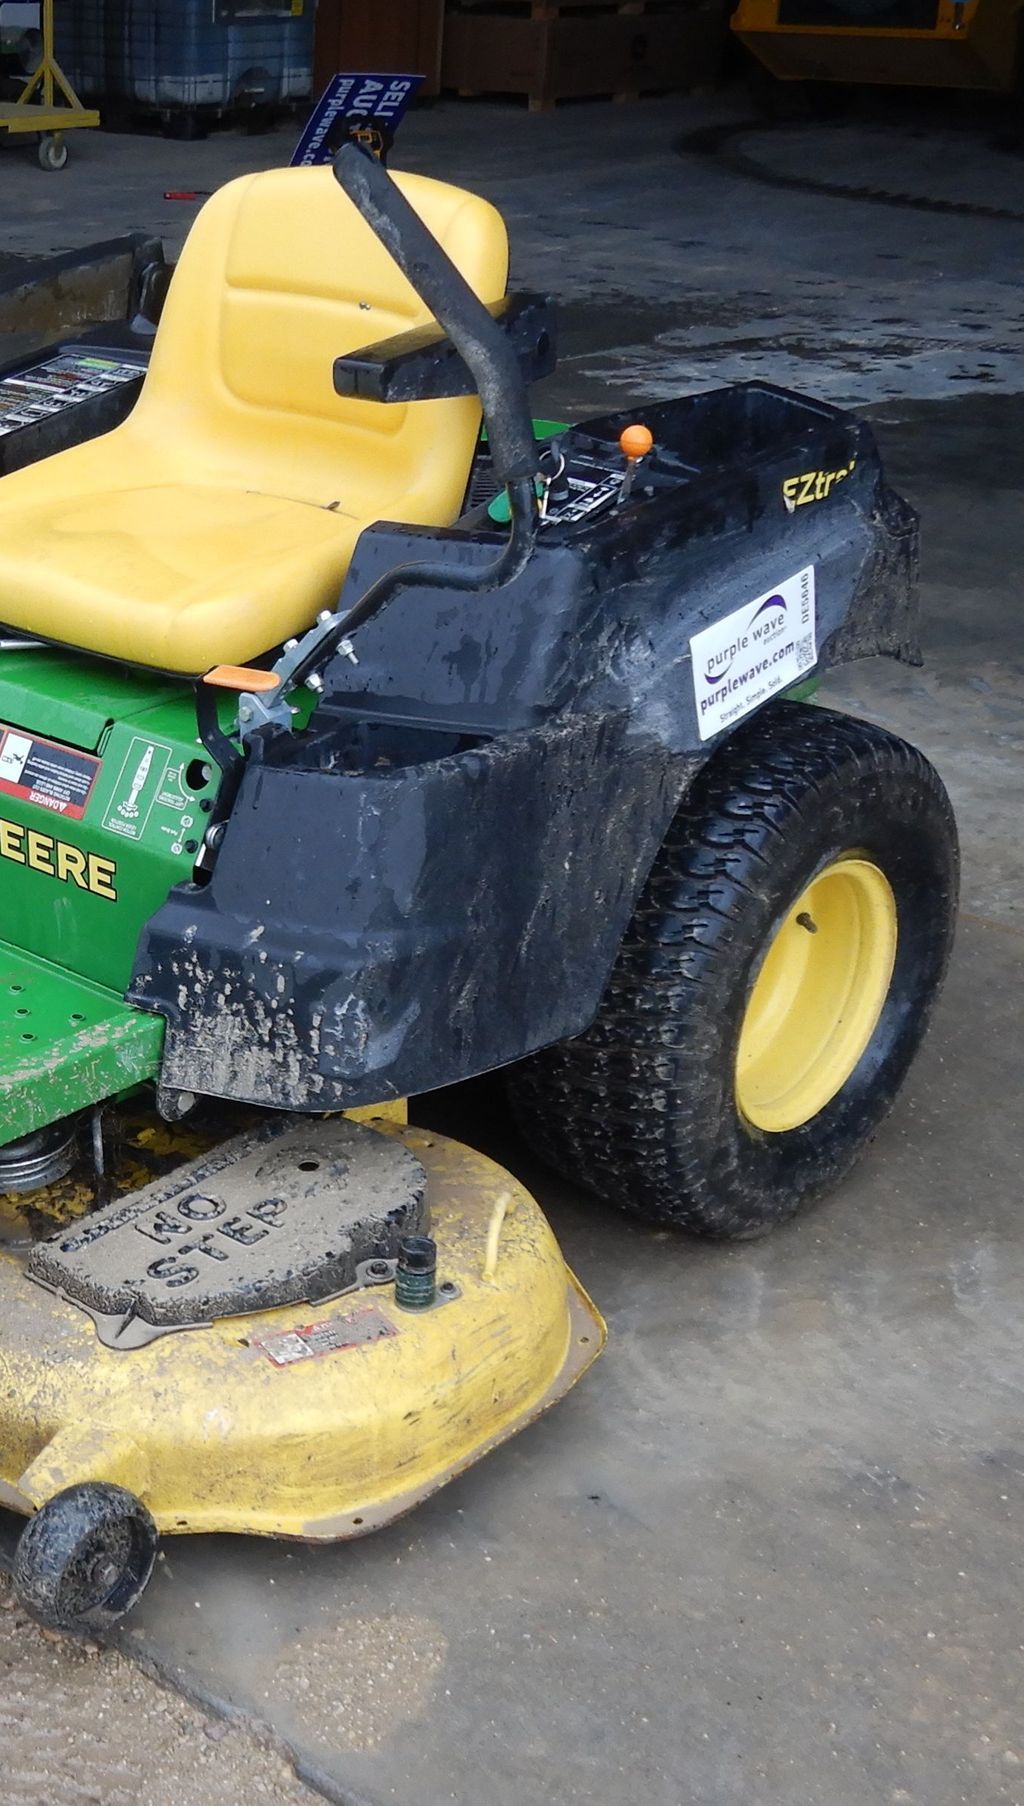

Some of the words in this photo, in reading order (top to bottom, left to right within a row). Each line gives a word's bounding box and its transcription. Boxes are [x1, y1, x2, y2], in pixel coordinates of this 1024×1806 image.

[299, 79, 355, 166] purplewave.co
[707, 635, 749, 674] purple
[752, 613, 785, 642] wave
[700, 641, 795, 715] purplewave.com
[29, 790, 60, 810] DANGER
[134, 1193, 227, 1245] NO
[146, 1197, 288, 1288] STEP
